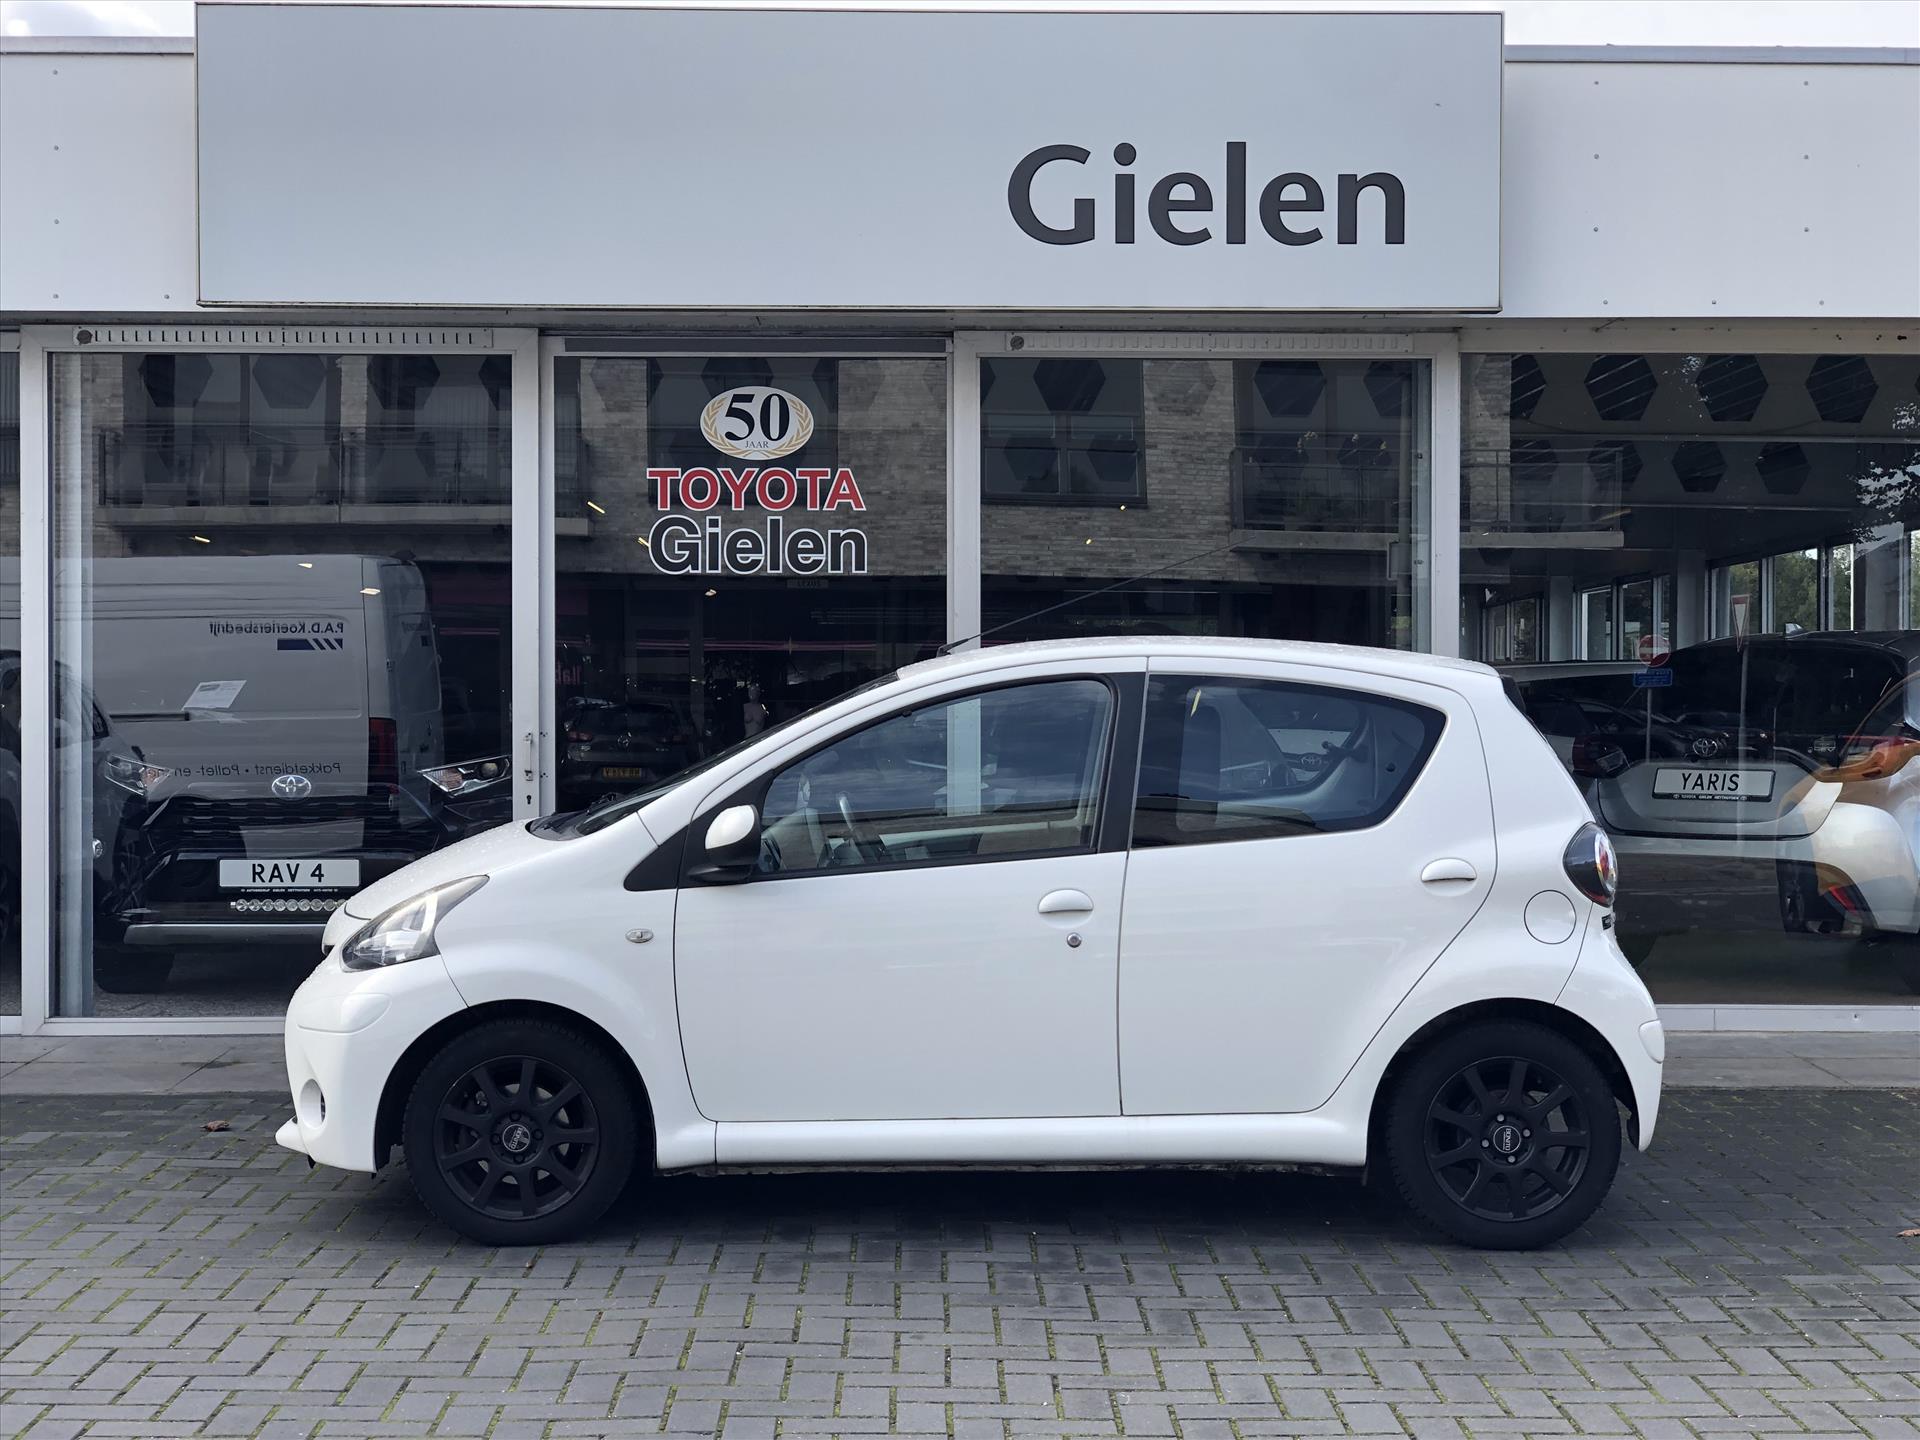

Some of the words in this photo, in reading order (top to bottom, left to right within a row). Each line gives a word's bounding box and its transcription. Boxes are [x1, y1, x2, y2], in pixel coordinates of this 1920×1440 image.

[1008, 142, 1405, 246] Gielen
[725, 393, 790, 441] 50
[647, 468, 866, 511] TOYOTA
[649, 514, 867, 575] Gielen
[1682, 773, 1740, 791] YARIS
[252, 863, 300, 883] RAV
[310, 863, 325, 883] 4
